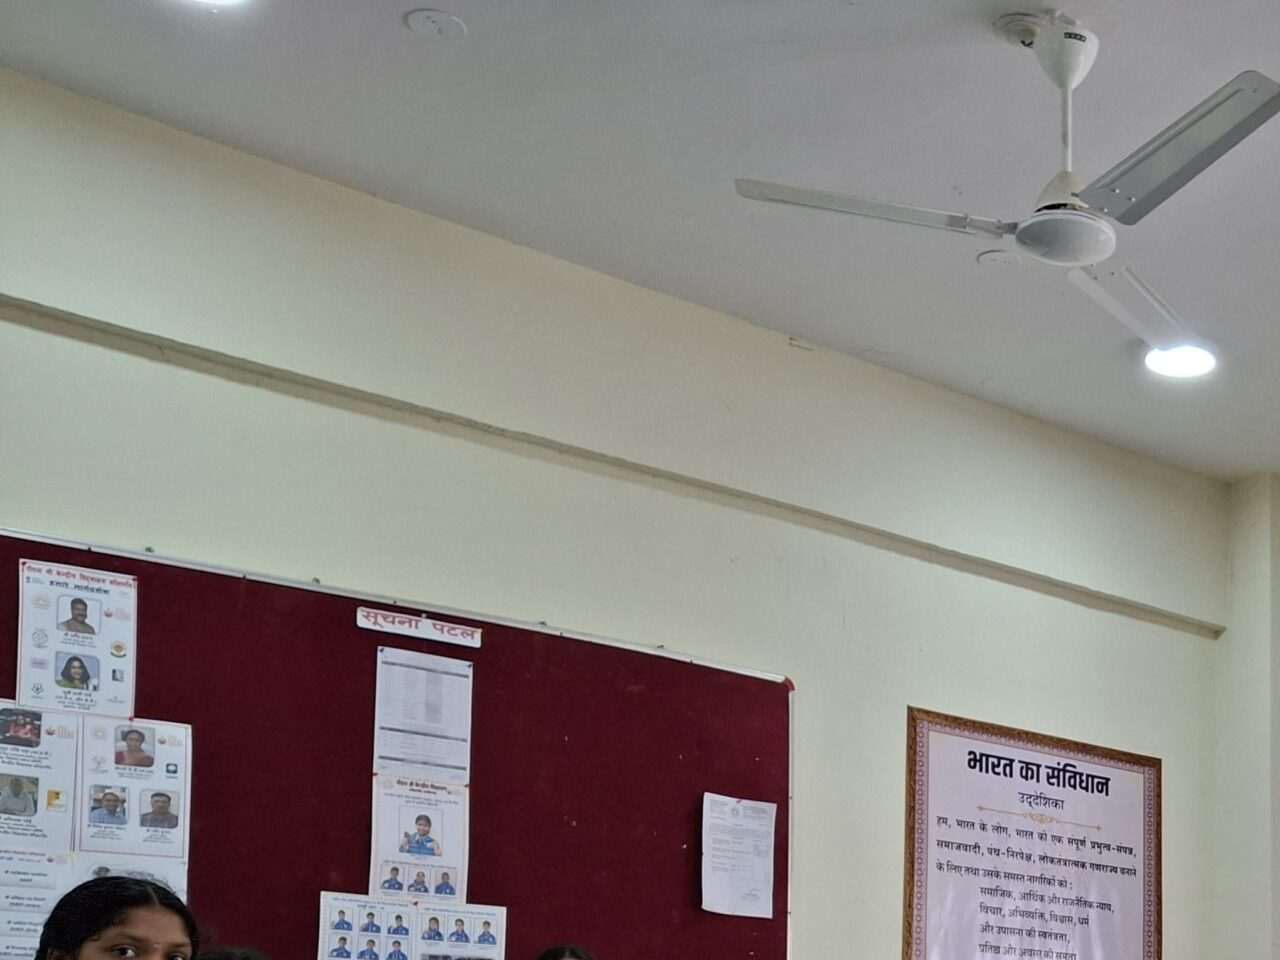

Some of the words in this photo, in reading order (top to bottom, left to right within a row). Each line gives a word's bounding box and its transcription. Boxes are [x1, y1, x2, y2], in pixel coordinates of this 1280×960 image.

[361, 610, 422, 629] सूचना
[432, 622, 478, 640] पटल
[967, 751, 1015, 778] भारत
[1019, 757, 1041, 783] का
[1047, 762, 1111, 796] संविधान
[936, 814, 951, 827] हम,
[956, 817, 974, 831] भारत
[978, 819, 987, 832] के
[991, 821, 1010, 837] लोग,
[1015, 827, 1033, 840] भारत
[1051, 833, 1063, 845] एक
[936, 836, 983, 855] समाजवादी,
[936, 859, 943, 871] के
[946, 860, 962, 876] लिए
[963, 865, 979, 876] तथा
[981, 865, 1000, 879] उसके
[1003, 870, 1024, 882] समस्त
[980, 901, 1005, 917] विचार,
[1047, 892, 1059, 905] और
[1096, 901, 1114, 913] न्याय,
[980, 921, 993, 934] और
[995, 925, 1023, 937] उपासना
[1025, 926, 1036, 938] की
[1003, 943, 1016, 956] और
